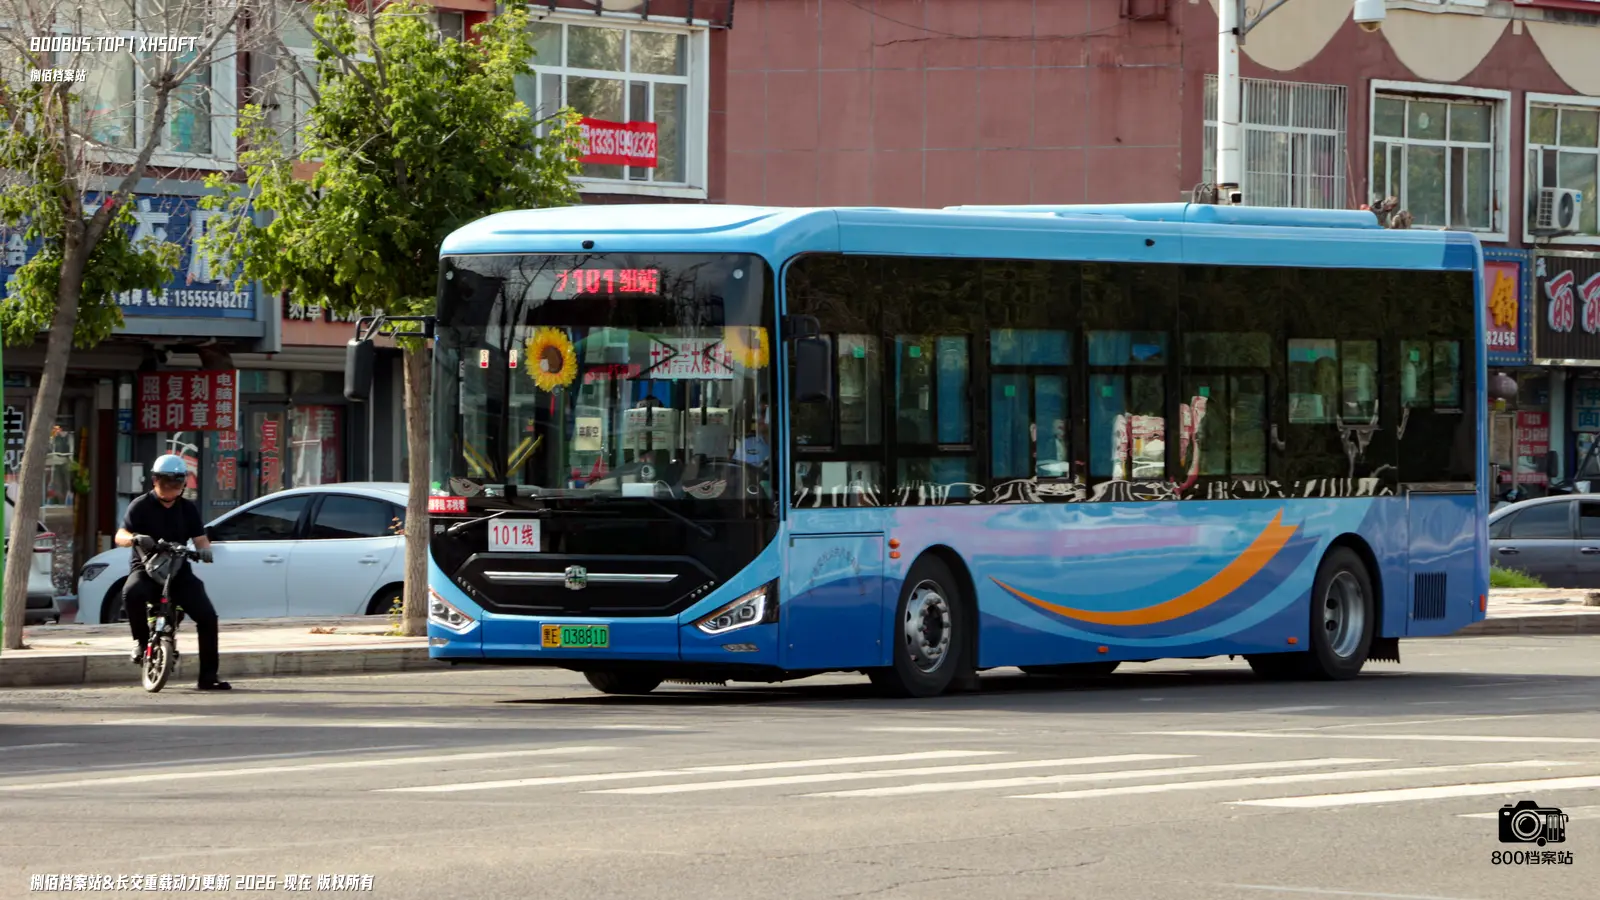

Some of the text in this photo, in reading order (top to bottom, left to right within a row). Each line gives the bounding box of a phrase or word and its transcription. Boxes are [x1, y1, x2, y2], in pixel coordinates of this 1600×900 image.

[142, 375, 161, 429] 照相
[166, 375, 184, 429] 复印
[190, 374, 210, 428] 刻章
[215, 373, 233, 428] 电脑维修
[493, 524, 534, 546] 101线
